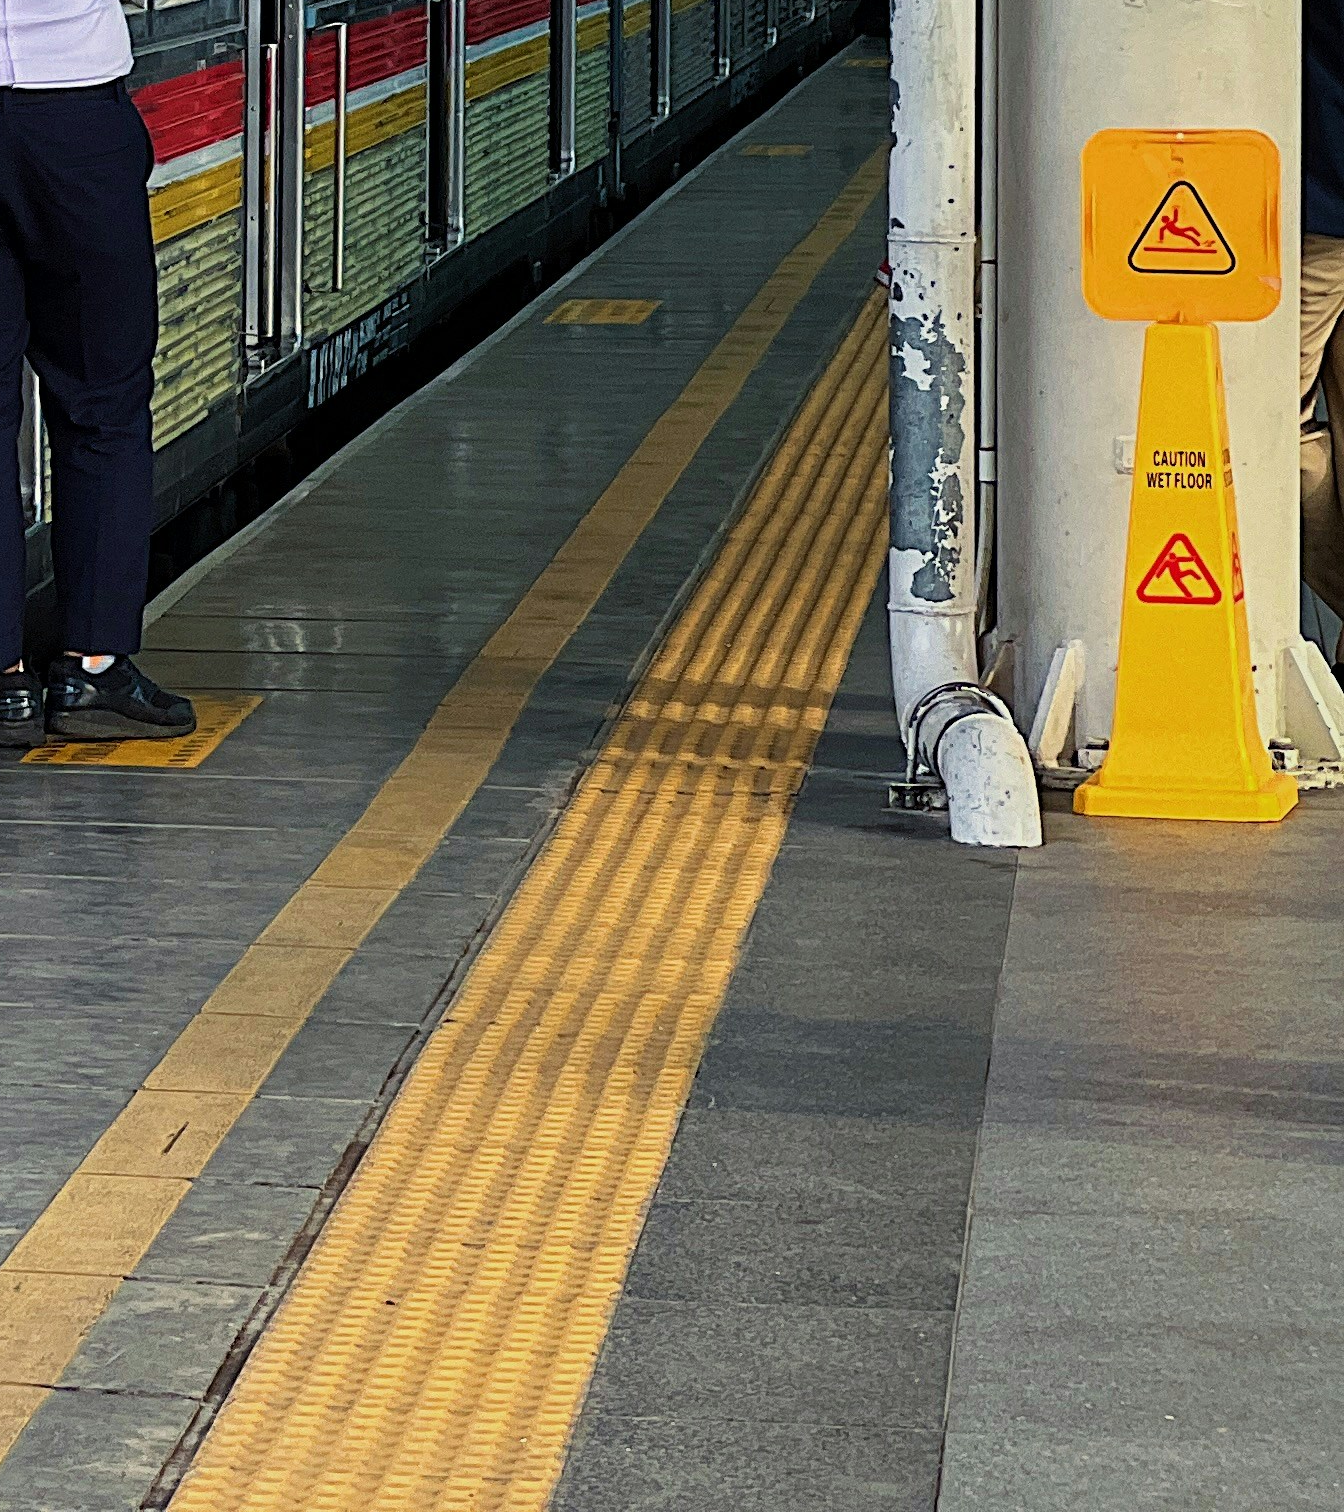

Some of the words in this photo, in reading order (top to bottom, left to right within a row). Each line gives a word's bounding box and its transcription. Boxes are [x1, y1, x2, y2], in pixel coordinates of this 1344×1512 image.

[1153, 450, 1206, 467] CAUTION
[1146, 472, 1172, 488] WET
[1174, 472, 1213, 489] FLOOR
